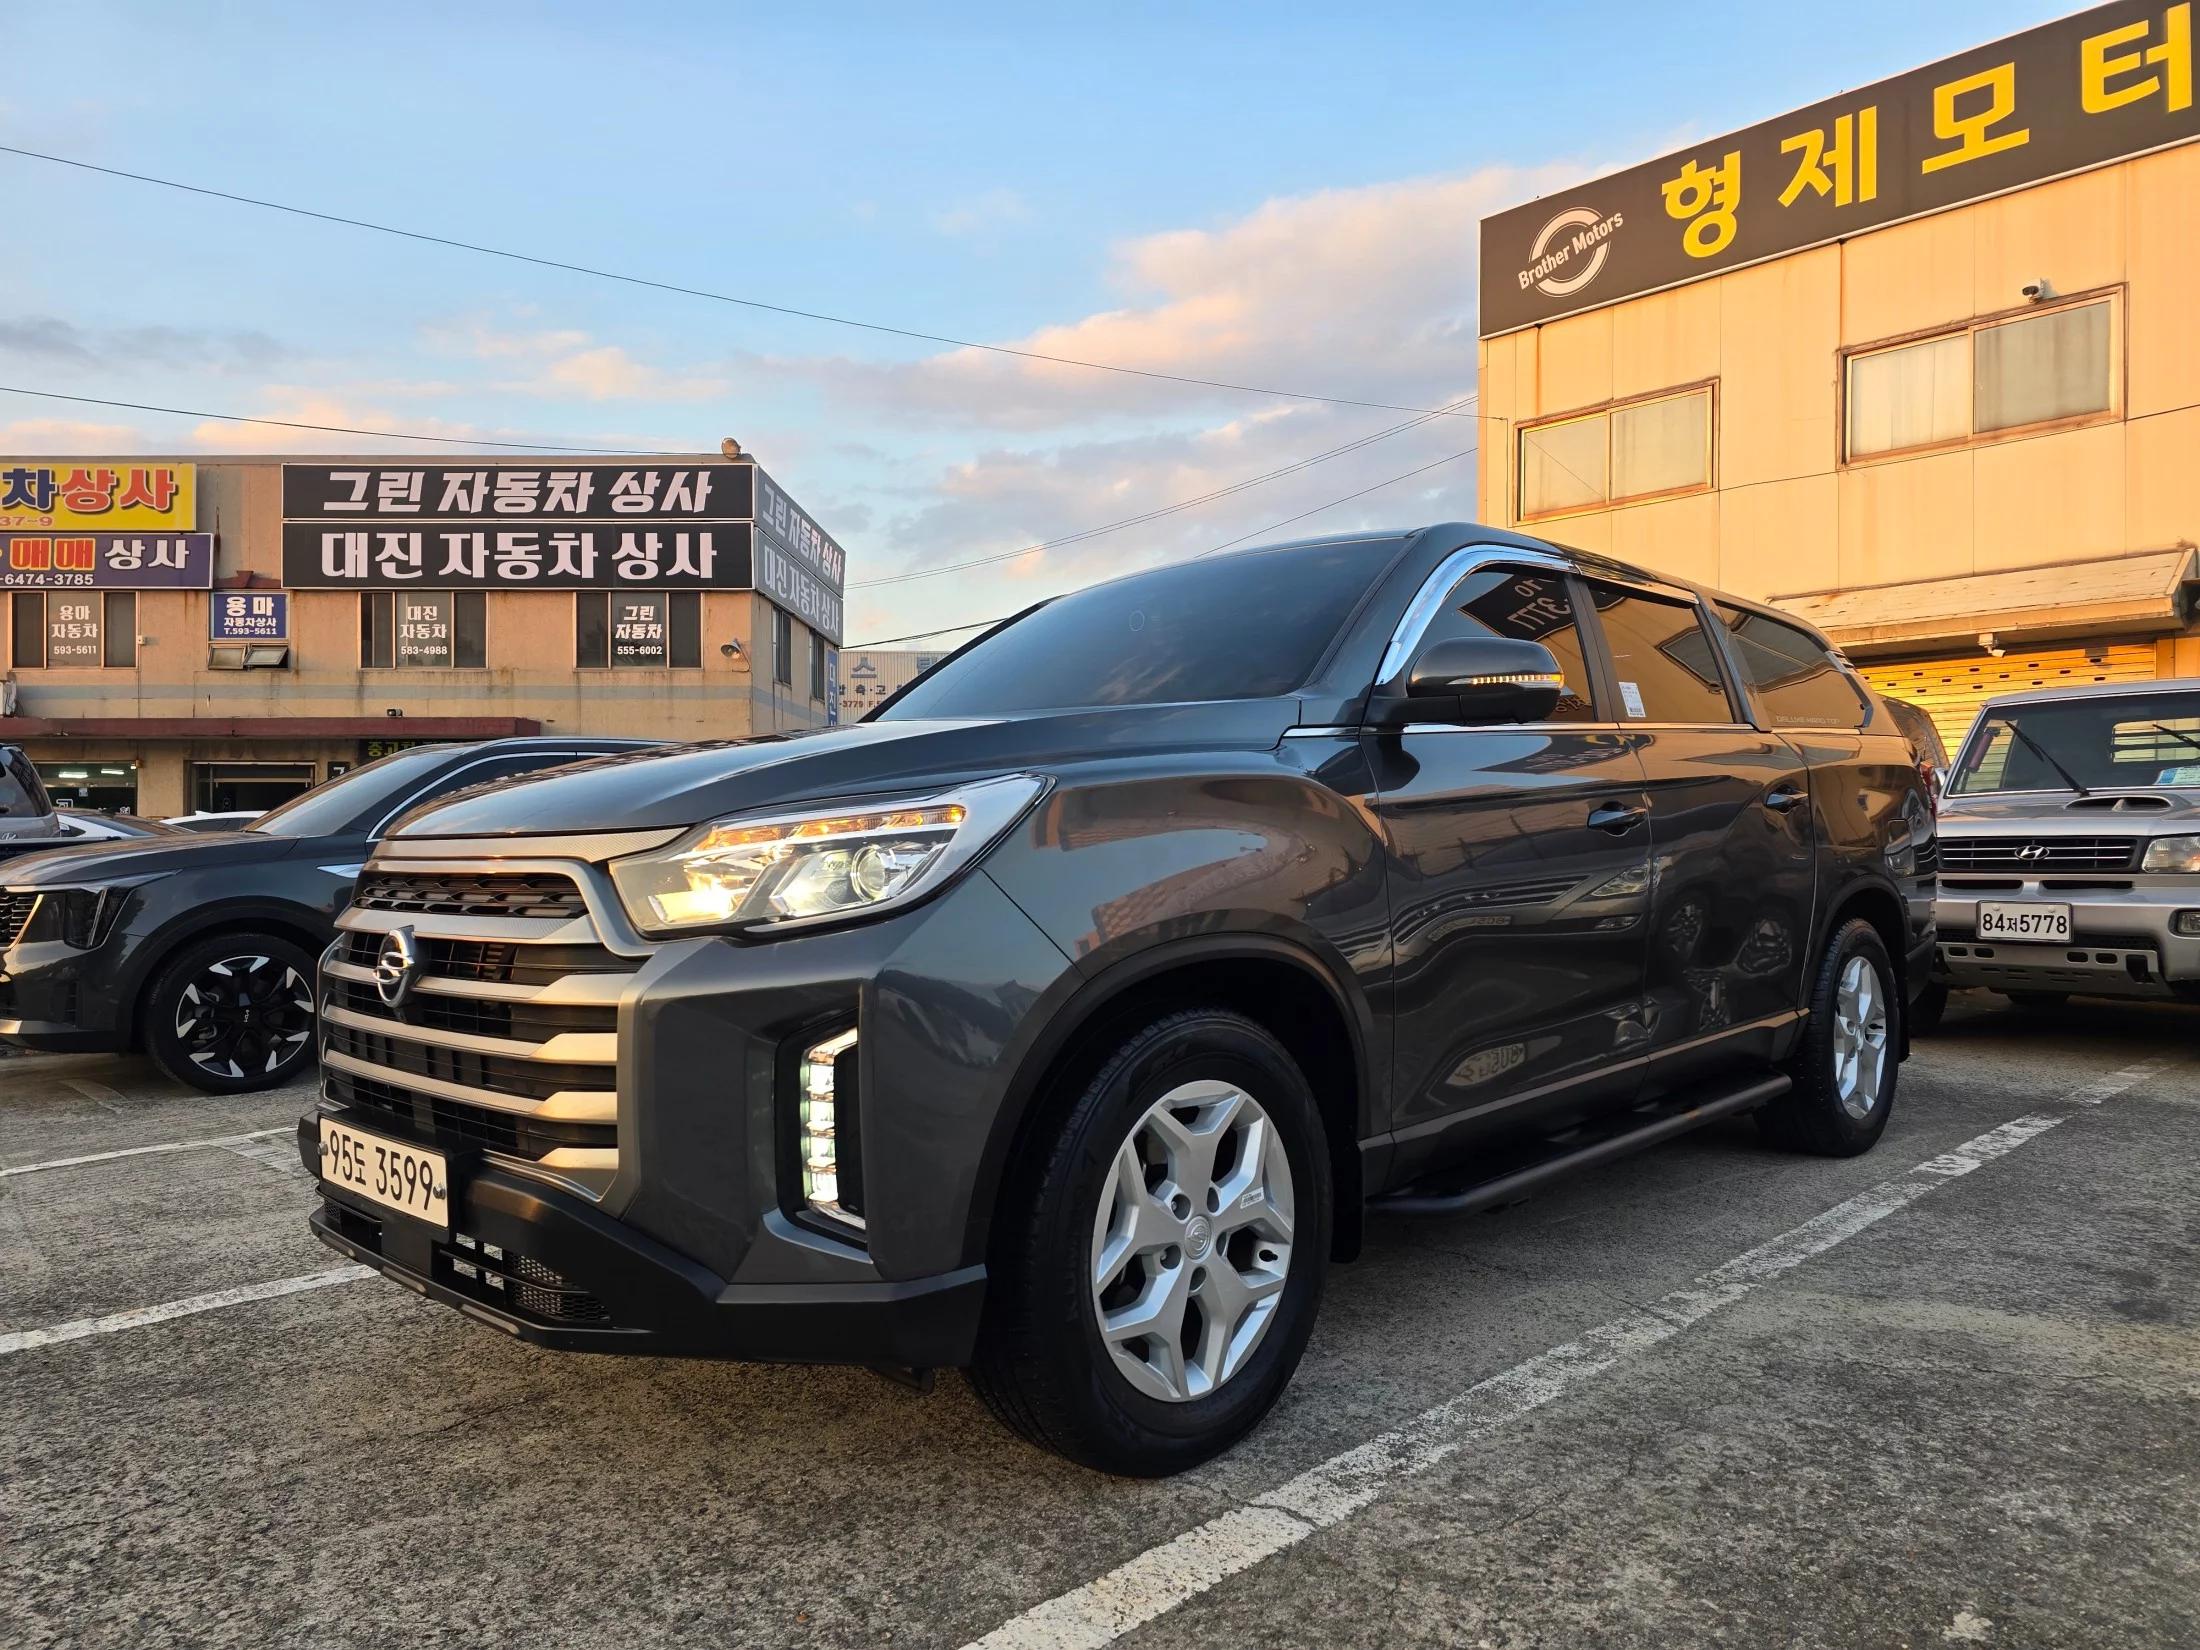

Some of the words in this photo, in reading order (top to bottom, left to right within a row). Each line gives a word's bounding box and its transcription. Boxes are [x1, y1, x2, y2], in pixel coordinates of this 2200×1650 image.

[1518, 245, 1570, 290] Brother
[1571, 212, 1624, 255] Motors
[323, 471, 425, 512] 그린
[437, 471, 595, 514] 자동차
[608, 471, 712, 513] 상사
[763, 483, 788, 538] 그린
[788, 507, 821, 568] 자동차
[822, 541, 842, 586] 상사
[10, 538, 96, 571] 매매
[105, 540, 189, 570] 상사
[321, 532, 423, 579] 대진
[438, 532, 598, 580] 자동차
[611, 532, 717, 580] 상사
[764, 545, 787, 598] 대진
[789, 565, 820, 623] 자동차
[821, 593, 840, 637] 상사
[60, 605, 91, 621] 용마
[226, 596, 275, 616] 용마
[407, 605, 438, 621] 대진
[623, 605, 655, 621] 그린
[51, 623, 98, 639] 자동차
[223, 627, 277, 635] T.593-5611
[400, 623, 448, 639] 자동차
[615, 623, 663, 639] 자동차
[53, 645, 97, 655] 593-5611
[401, 645, 448, 655] 583-4988
[617, 645, 663, 655] 555-6002
[1983, 913, 2067, 933] 84저5778
[330, 1130, 366, 1185] 95도
[375, 1146, 433, 1210] 3599
